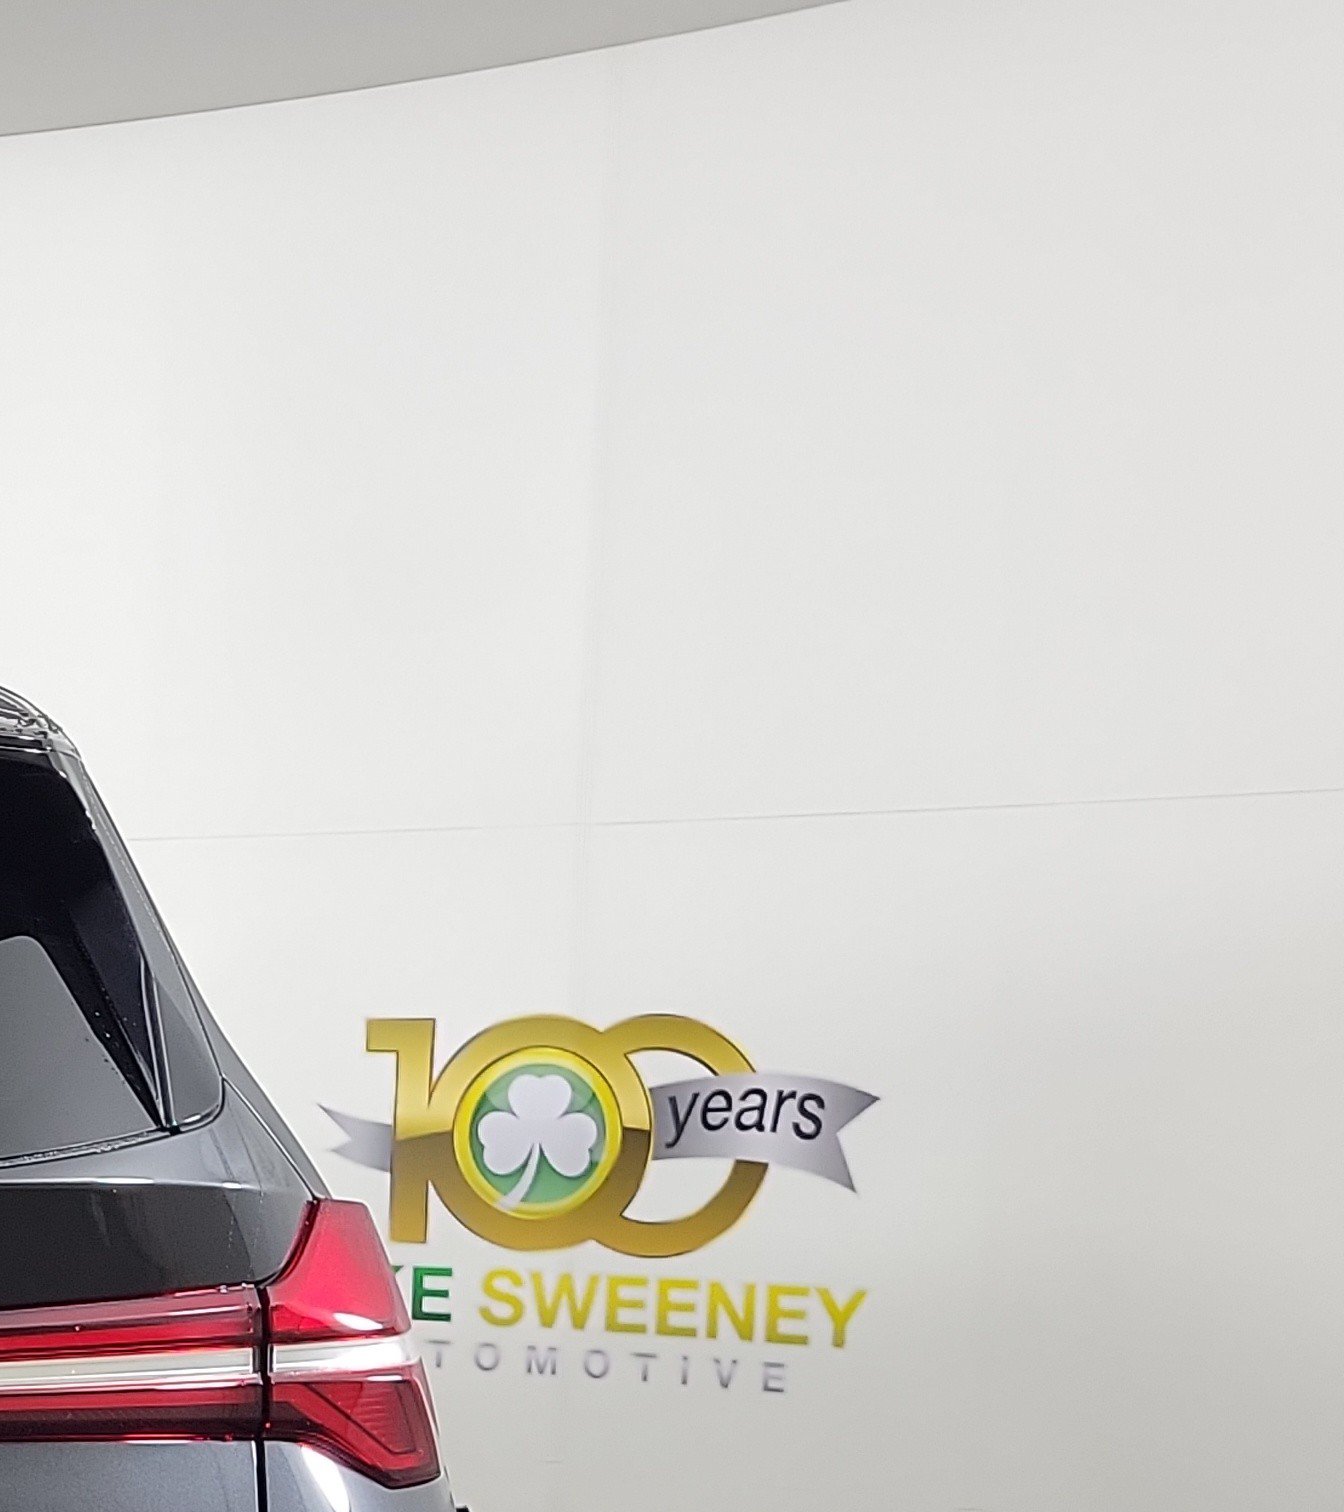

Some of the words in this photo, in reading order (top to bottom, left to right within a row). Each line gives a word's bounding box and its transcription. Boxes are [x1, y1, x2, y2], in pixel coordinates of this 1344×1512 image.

[365, 1012, 769, 1258] 100
[664, 1086, 826, 1148] years
[477, 1267, 868, 1349] SWEENEY
[424, 1339, 787, 1394] TOMOTIVE
